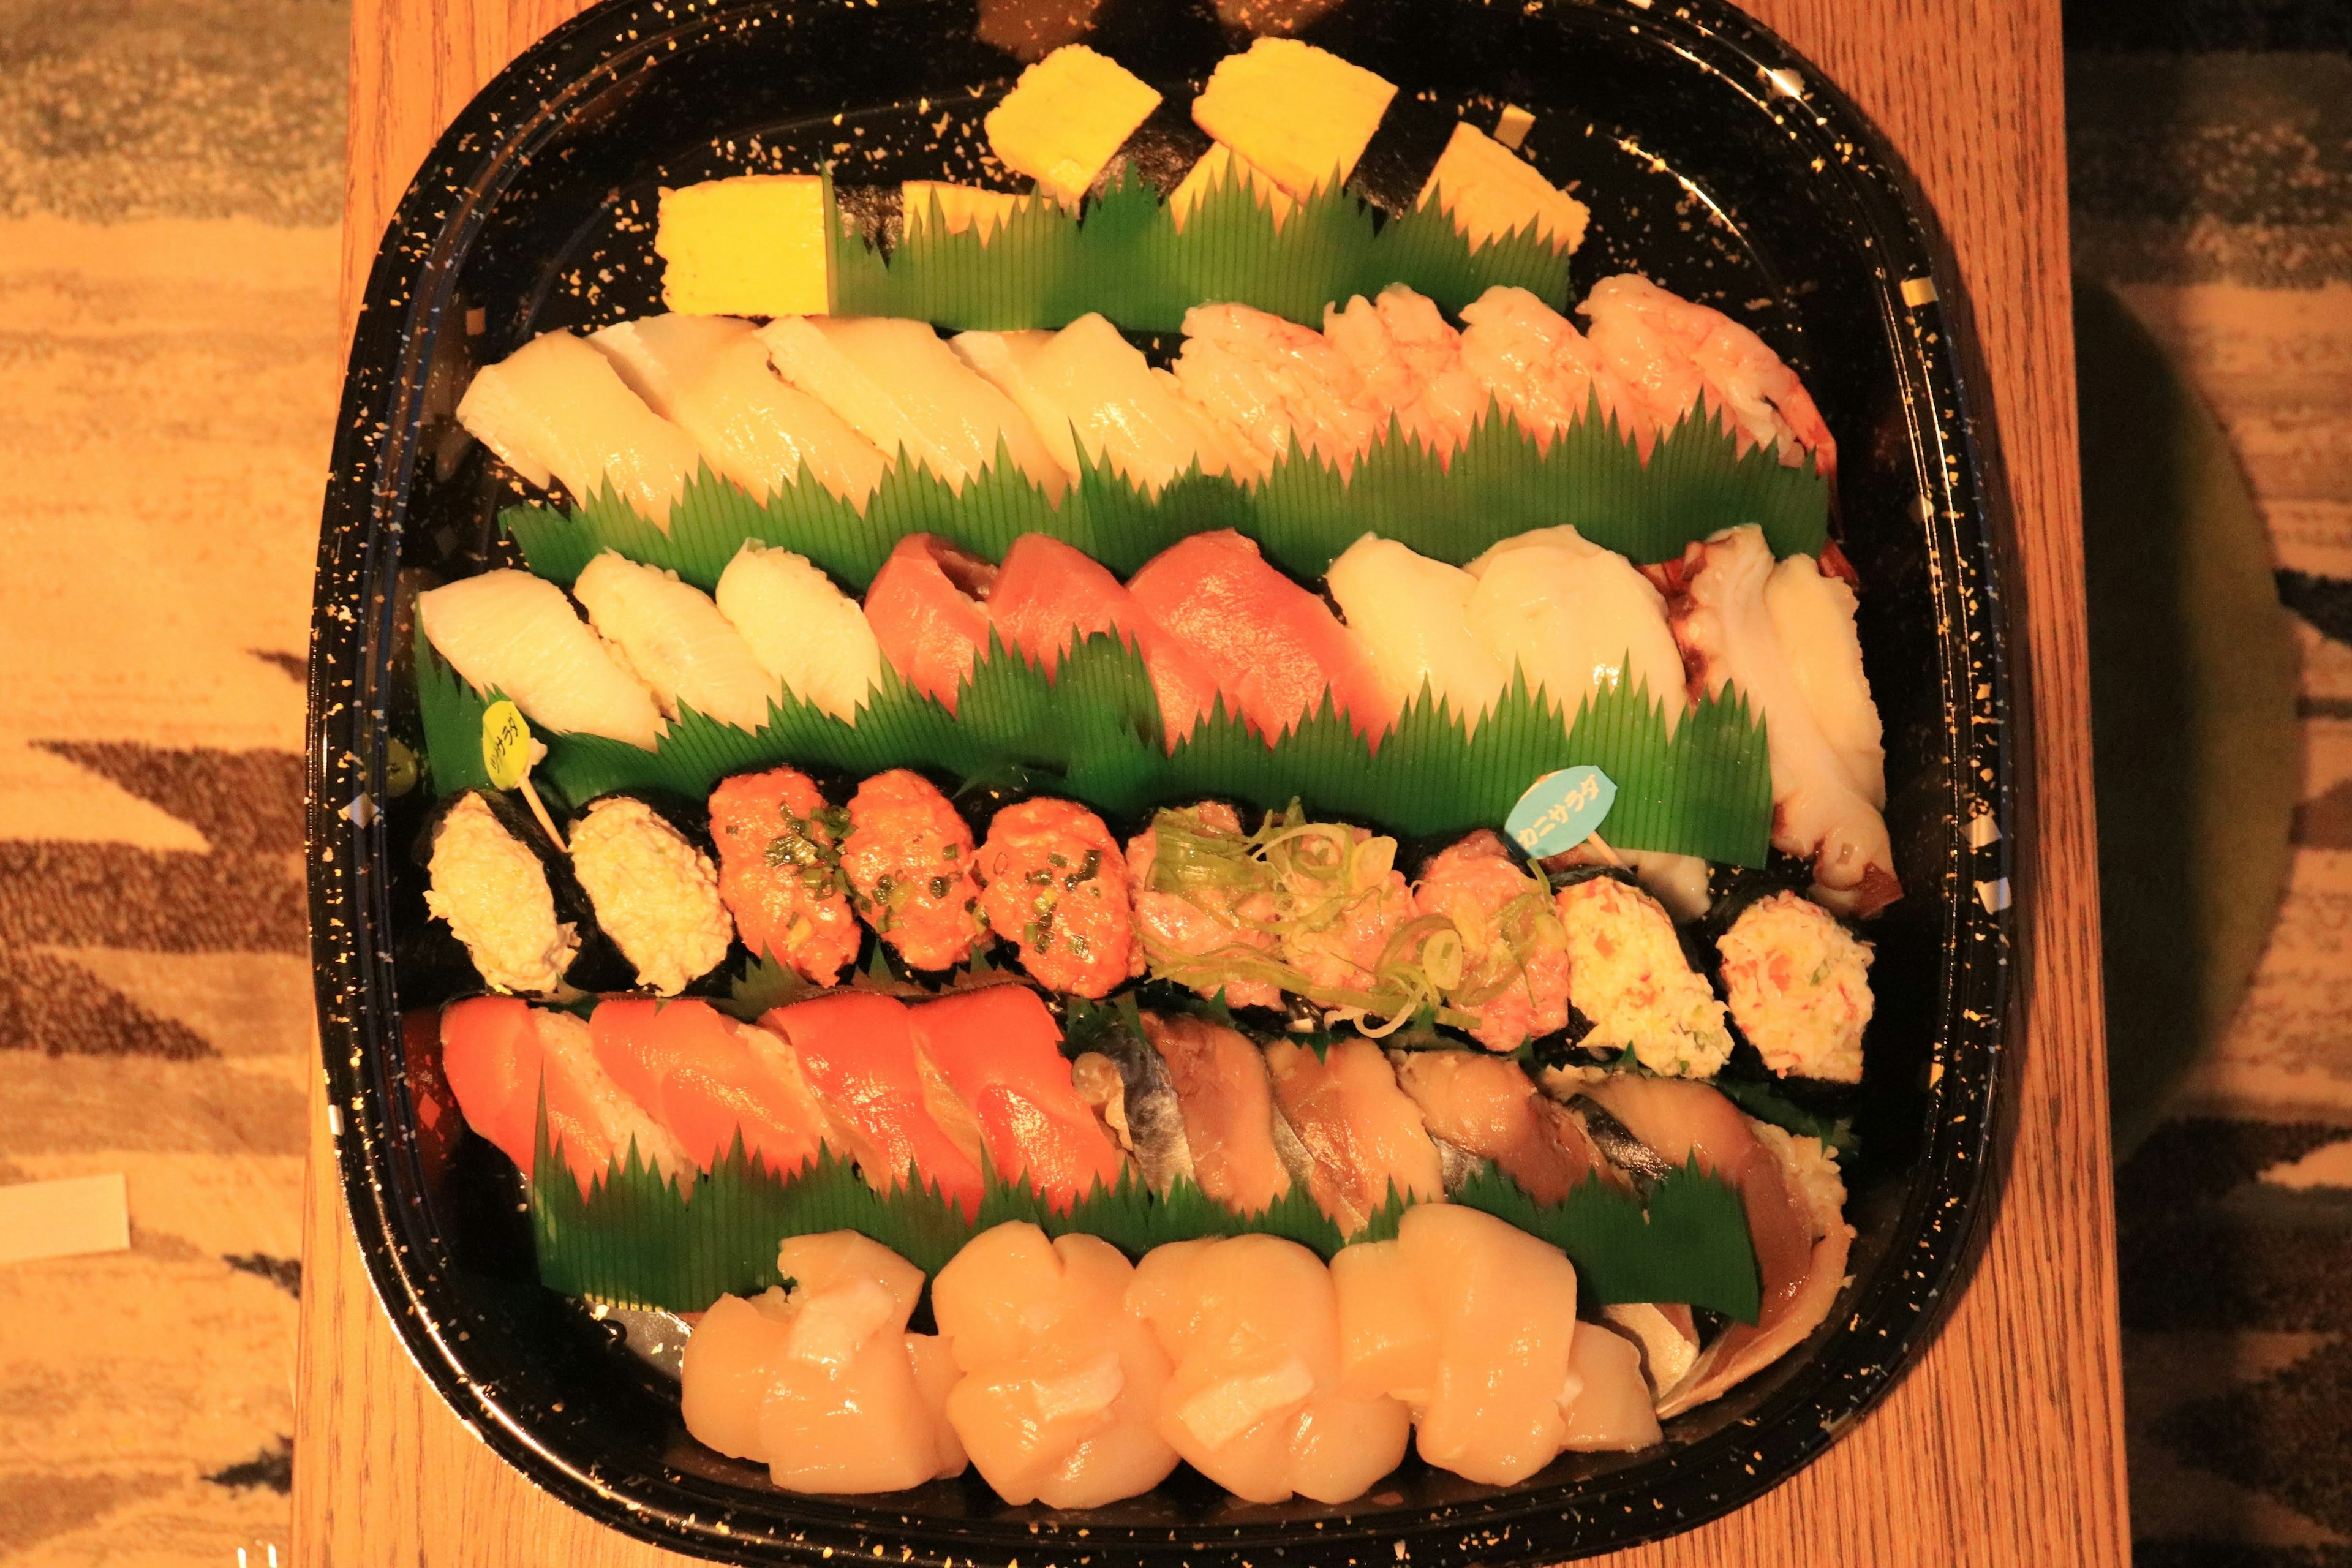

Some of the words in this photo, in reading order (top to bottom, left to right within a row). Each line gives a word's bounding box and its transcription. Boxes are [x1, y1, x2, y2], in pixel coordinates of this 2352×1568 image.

[1517, 774, 1600, 850] カニサラダ
